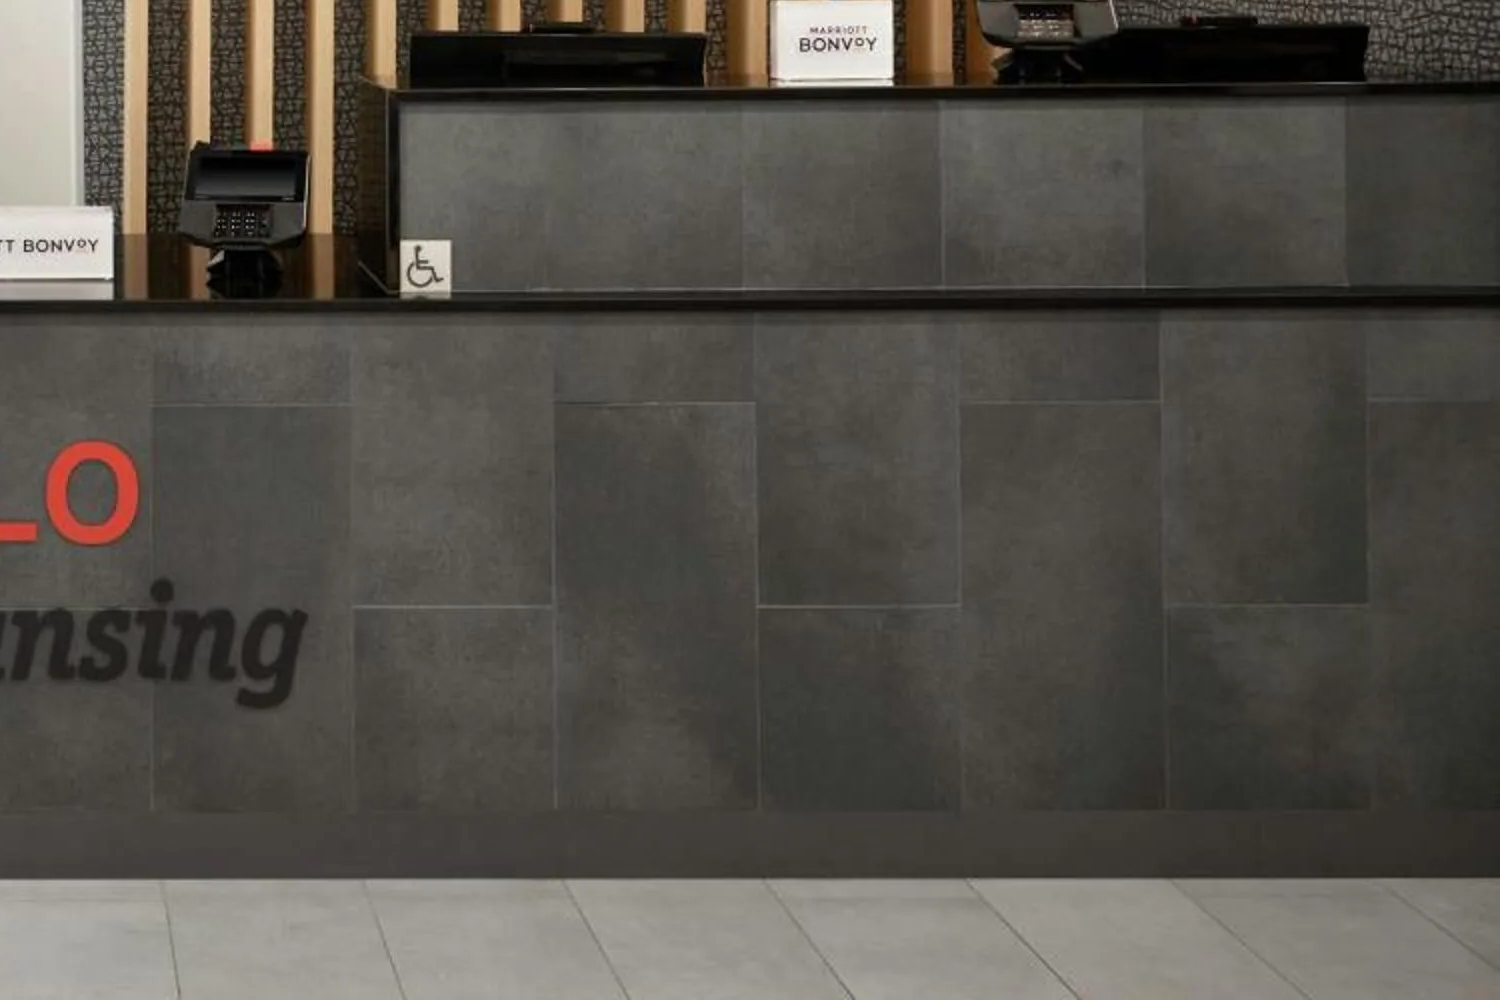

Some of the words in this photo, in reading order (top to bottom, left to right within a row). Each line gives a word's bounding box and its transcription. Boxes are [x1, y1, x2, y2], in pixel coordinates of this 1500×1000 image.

[809, 25, 868, 35] MARRIOTT
[799, 37, 877, 53] BONVOY
[23, 239, 99, 253] BONVOY
